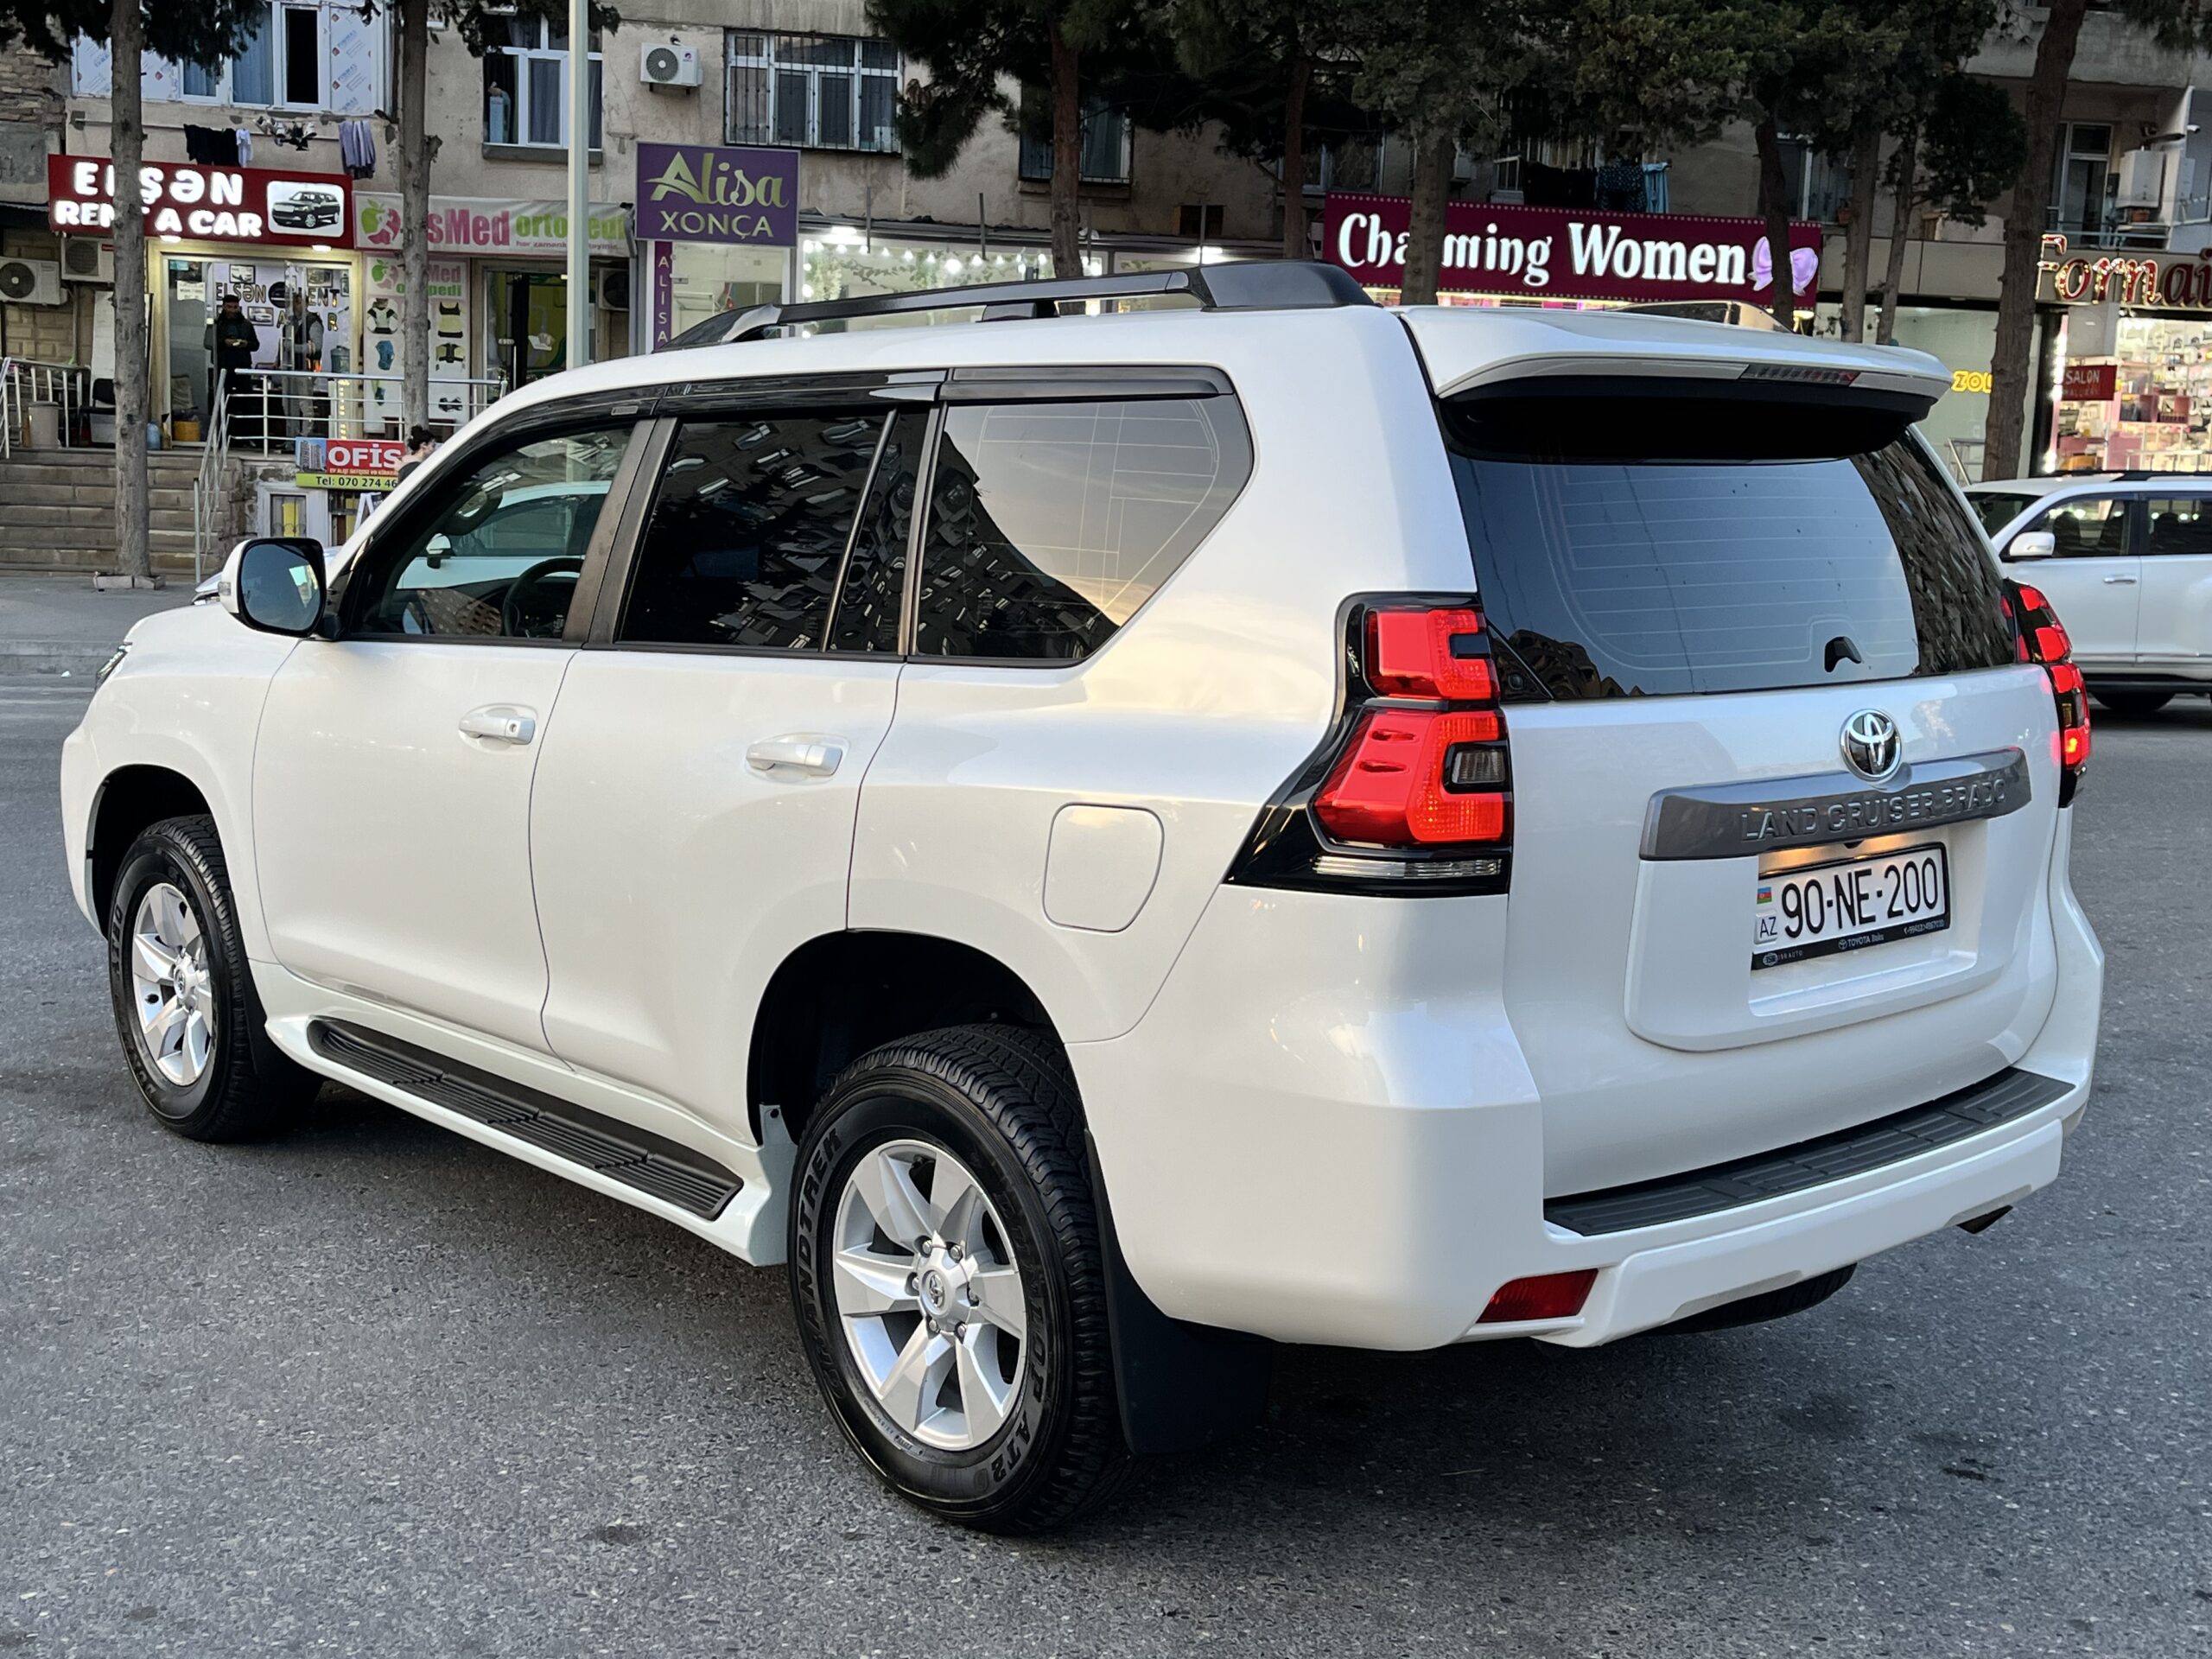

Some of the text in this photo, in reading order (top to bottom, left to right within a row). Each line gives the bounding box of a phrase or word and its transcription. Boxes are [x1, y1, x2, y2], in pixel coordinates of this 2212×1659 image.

[644, 151, 789, 208] Alisa
[54, 200, 263, 237] REN A CAR
[516, 213, 626, 241] ortoedi
[659, 210, 774, 239] XONÇA
[1338, 213, 1746, 287] Chaming Women
[658, 256, 670, 342] ALISA
[2065, 370, 2101, 385] SALON
[328, 443, 402, 469] OFİS
[316, 476, 335, 486] Tel:
[339, 477, 359, 487] 070
[362, 478, 381, 488] 274
[1741, 778, 2007, 842] LAND CRUISER PRADO
[1759, 916, 1778, 938] AZ
[1847, 935, 1872, 948] TOYOTA
[797, 1127, 847, 1402] GRANDTREK
